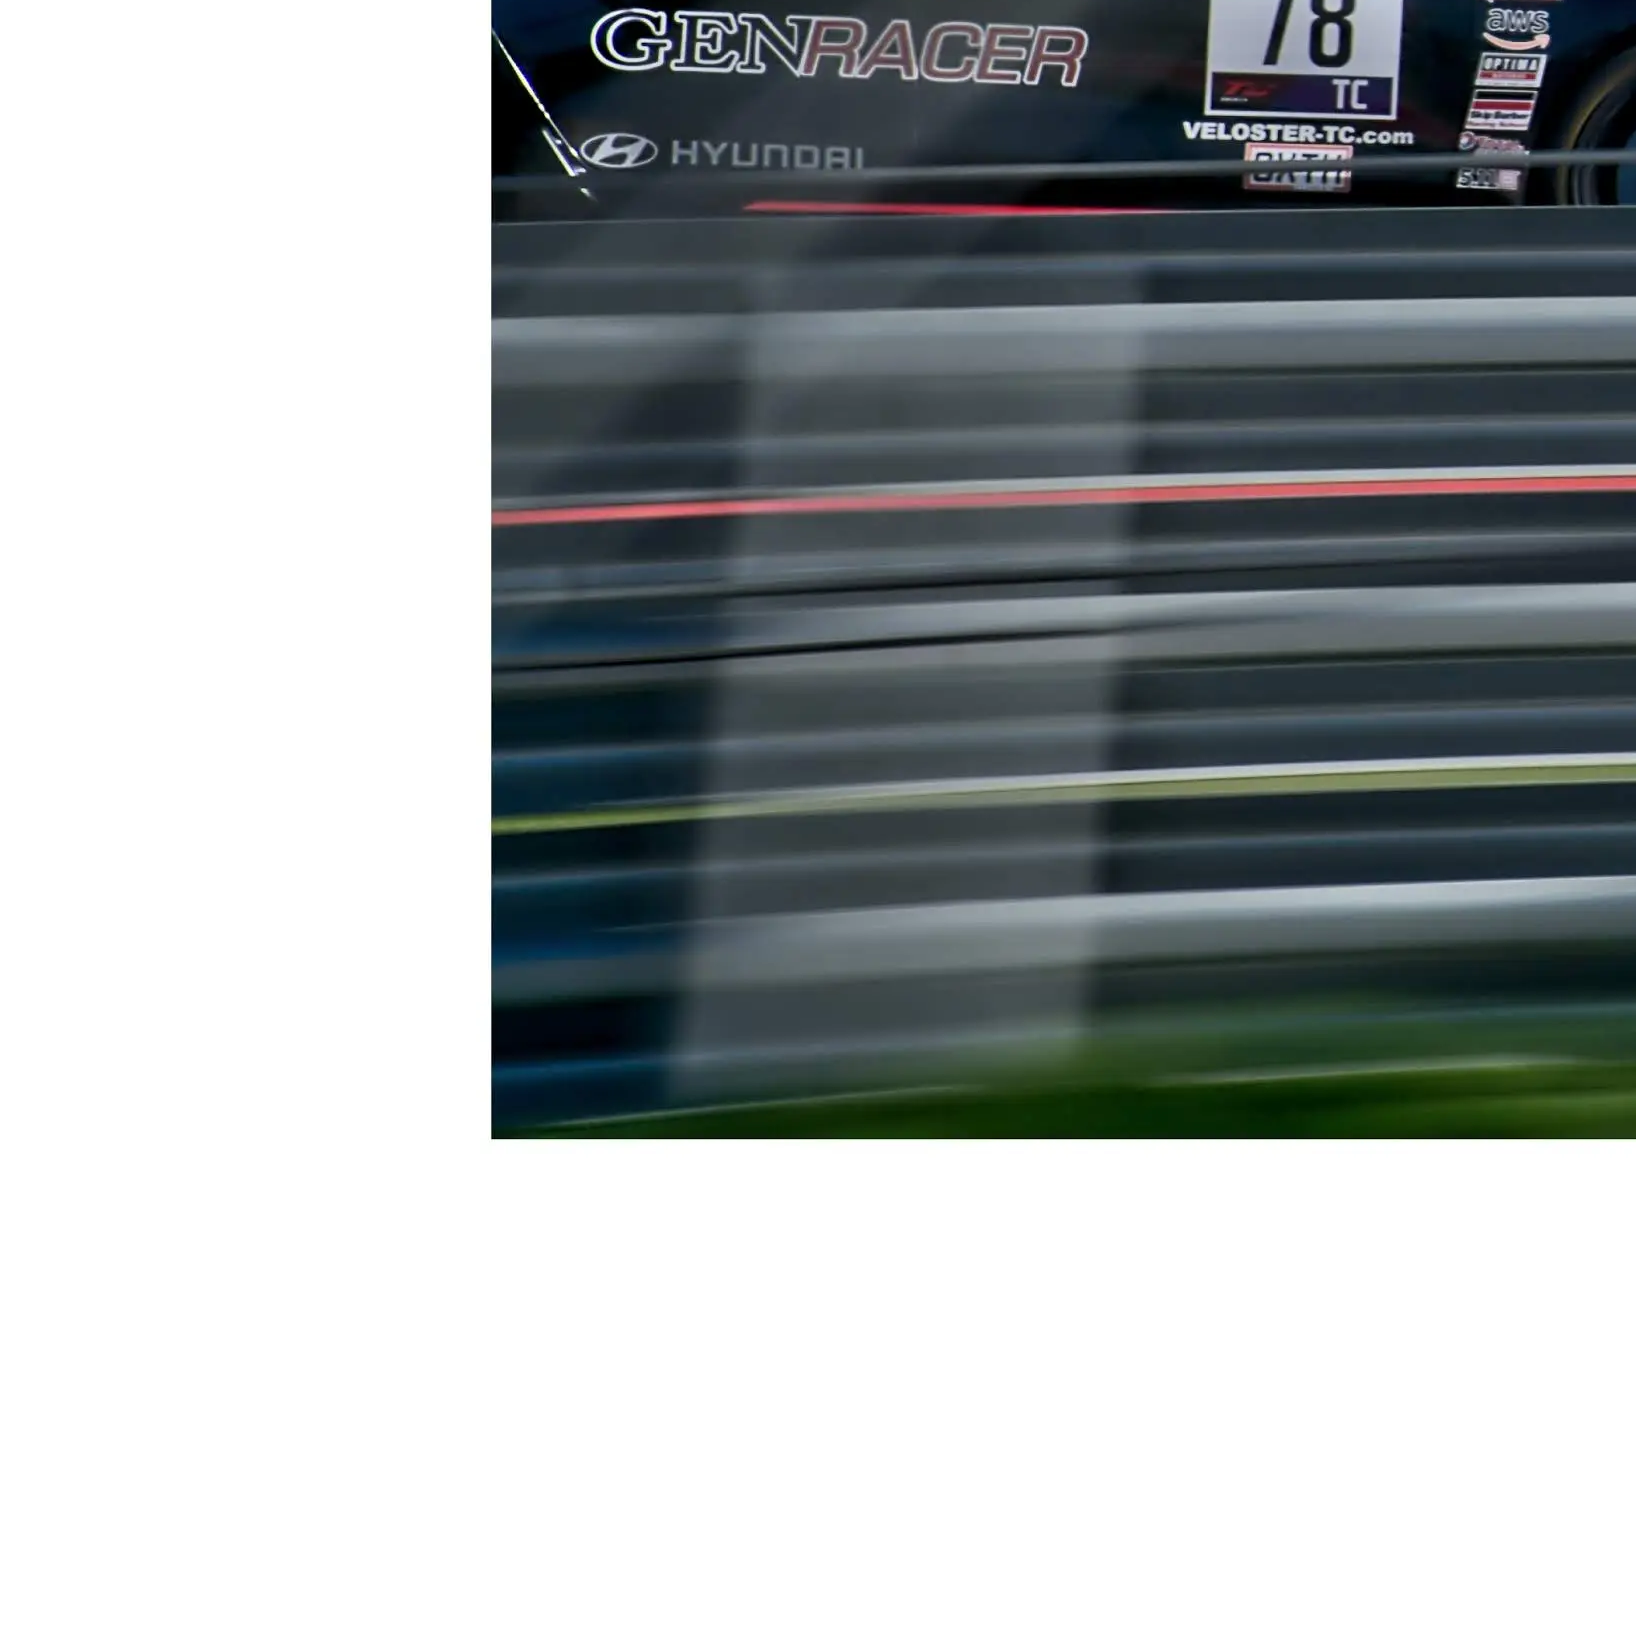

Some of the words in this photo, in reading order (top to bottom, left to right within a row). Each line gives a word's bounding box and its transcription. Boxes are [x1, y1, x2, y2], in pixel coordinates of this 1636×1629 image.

[1486, 7, 1550, 34] aws
[589, 8, 1090, 87] GENRACER
[1484, 57, 1538, 71] OPTIMA
[1331, 78, 1369, 110] TC
[1182, 121, 1414, 145] VELOSTER-TC.com
[671, 139, 864, 170] HYUNDAI
